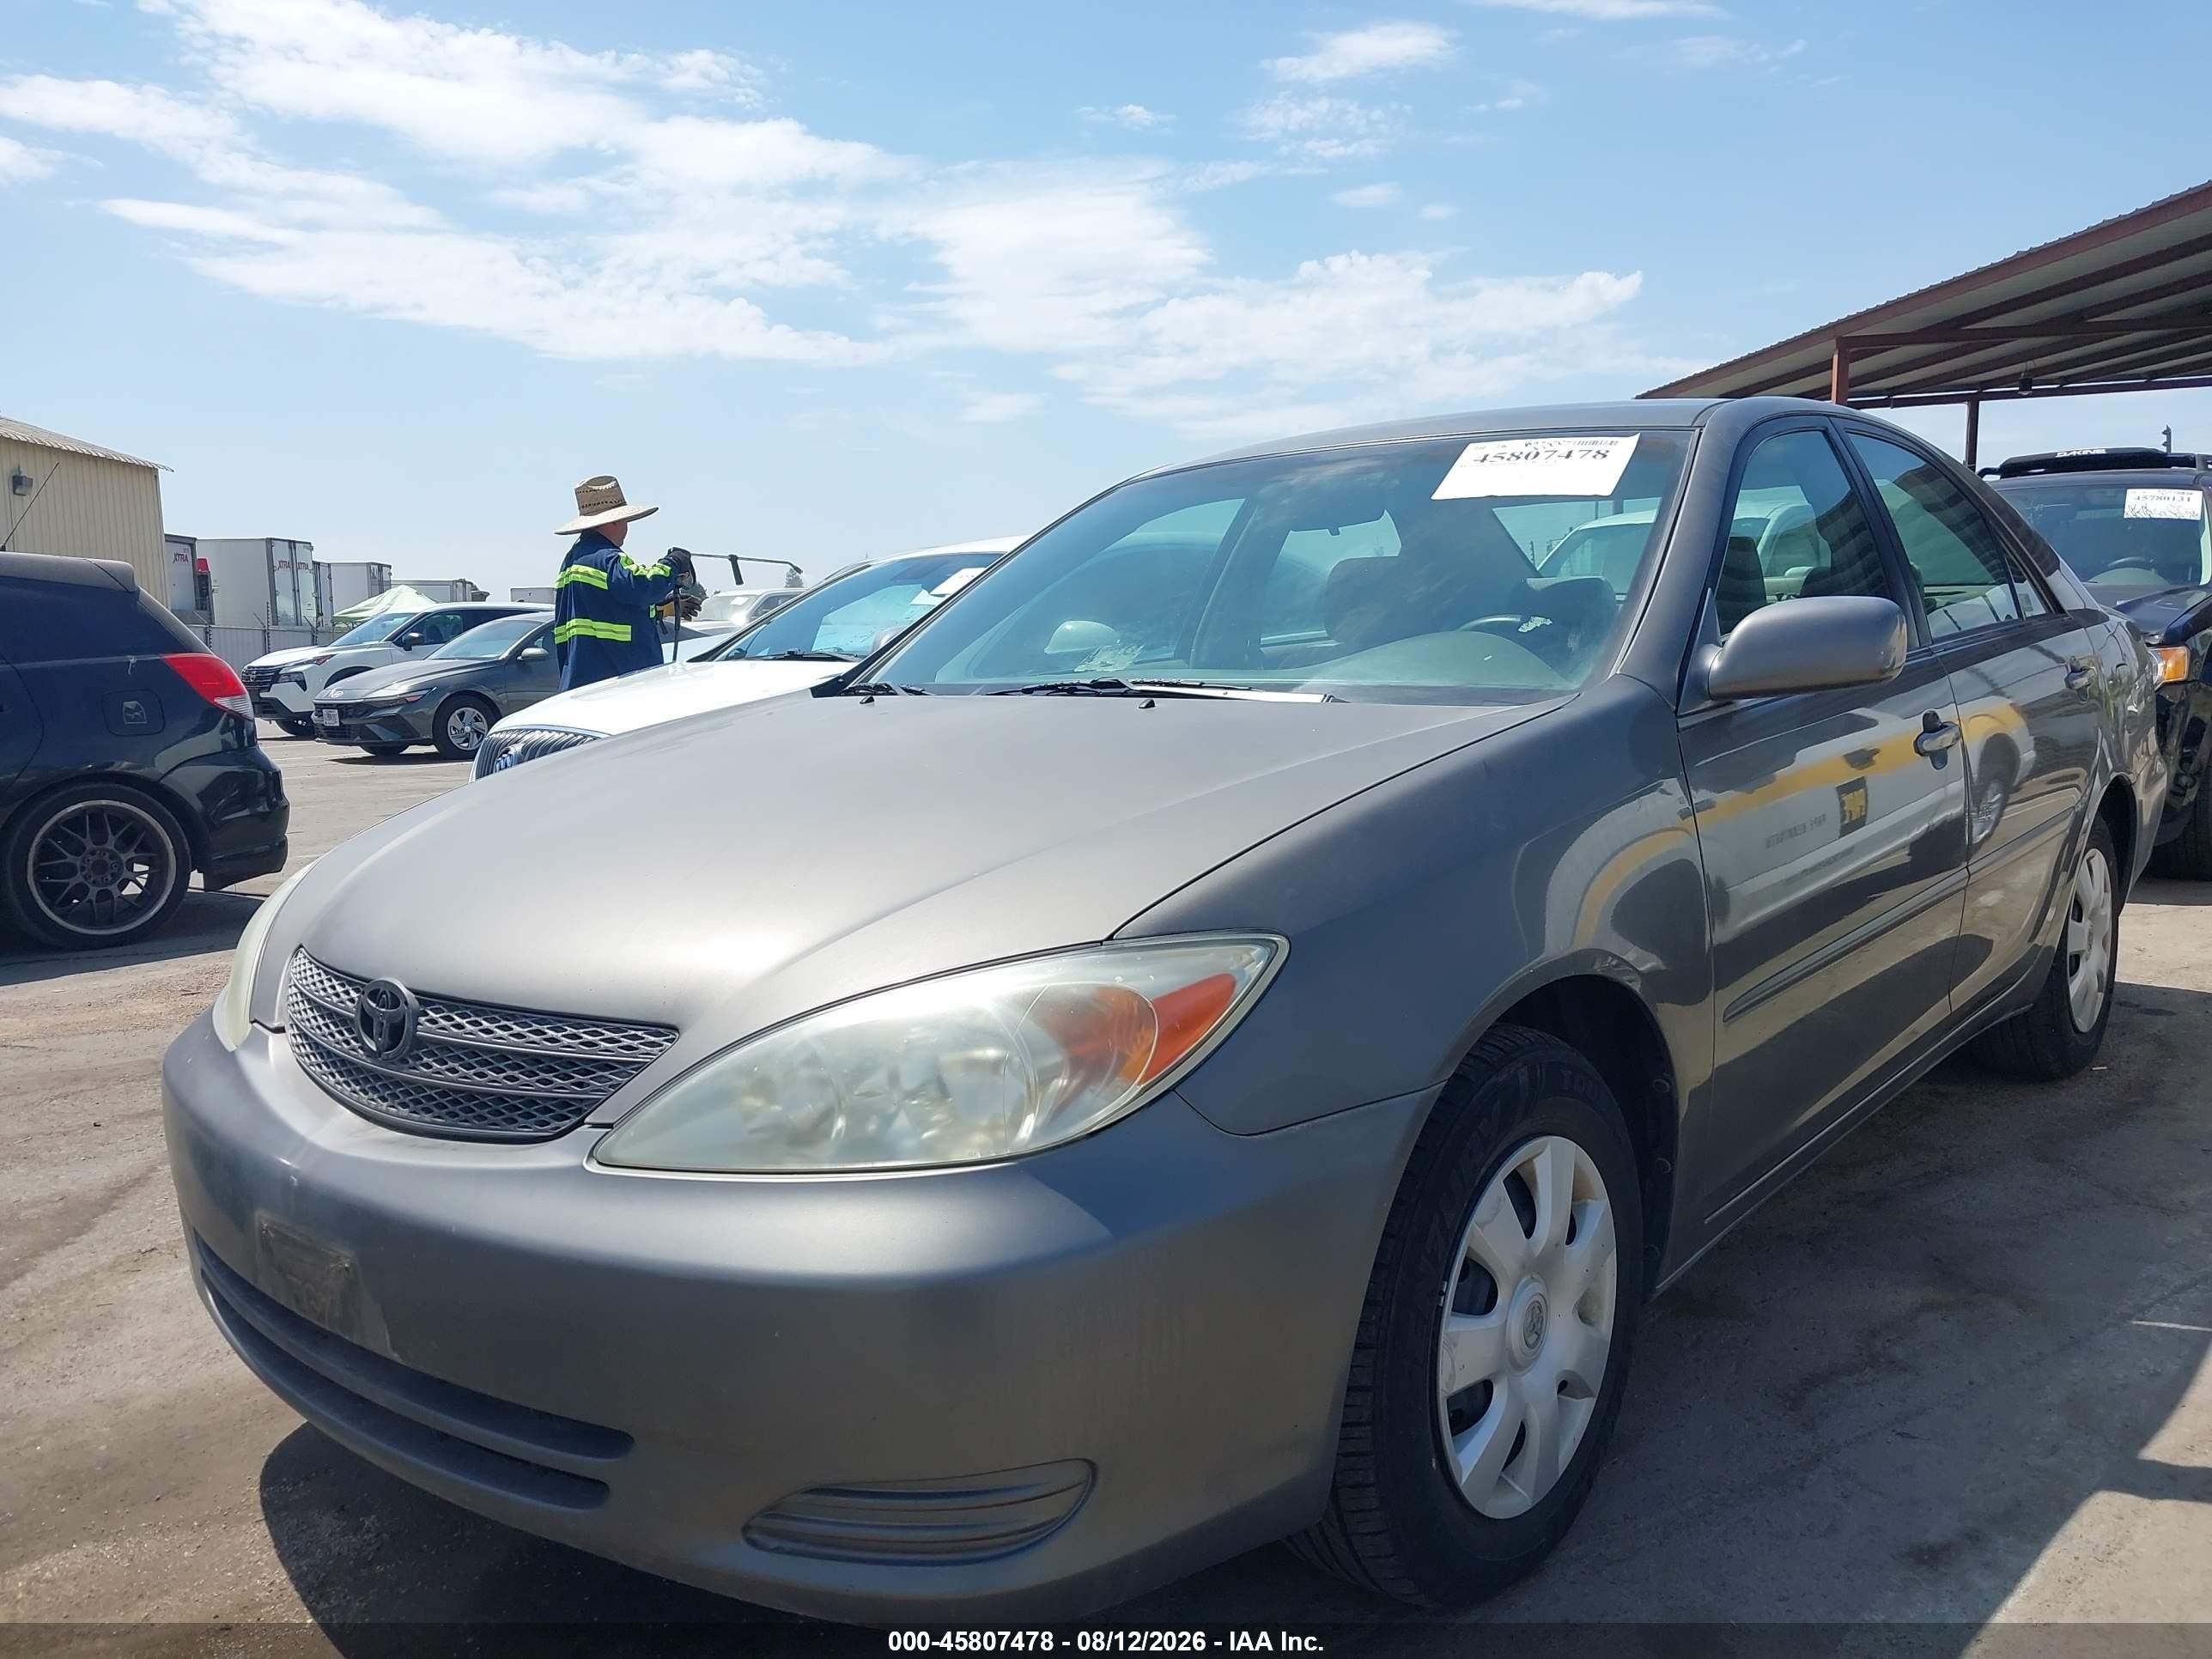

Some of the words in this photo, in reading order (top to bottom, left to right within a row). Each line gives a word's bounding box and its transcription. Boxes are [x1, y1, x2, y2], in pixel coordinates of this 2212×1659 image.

[1474, 449, 1610, 464] 45807478
[2055, 448, 2107, 458] DAKINE
[173, 552, 189, 563] XTRA
[277, 560, 290, 570] XTRA
